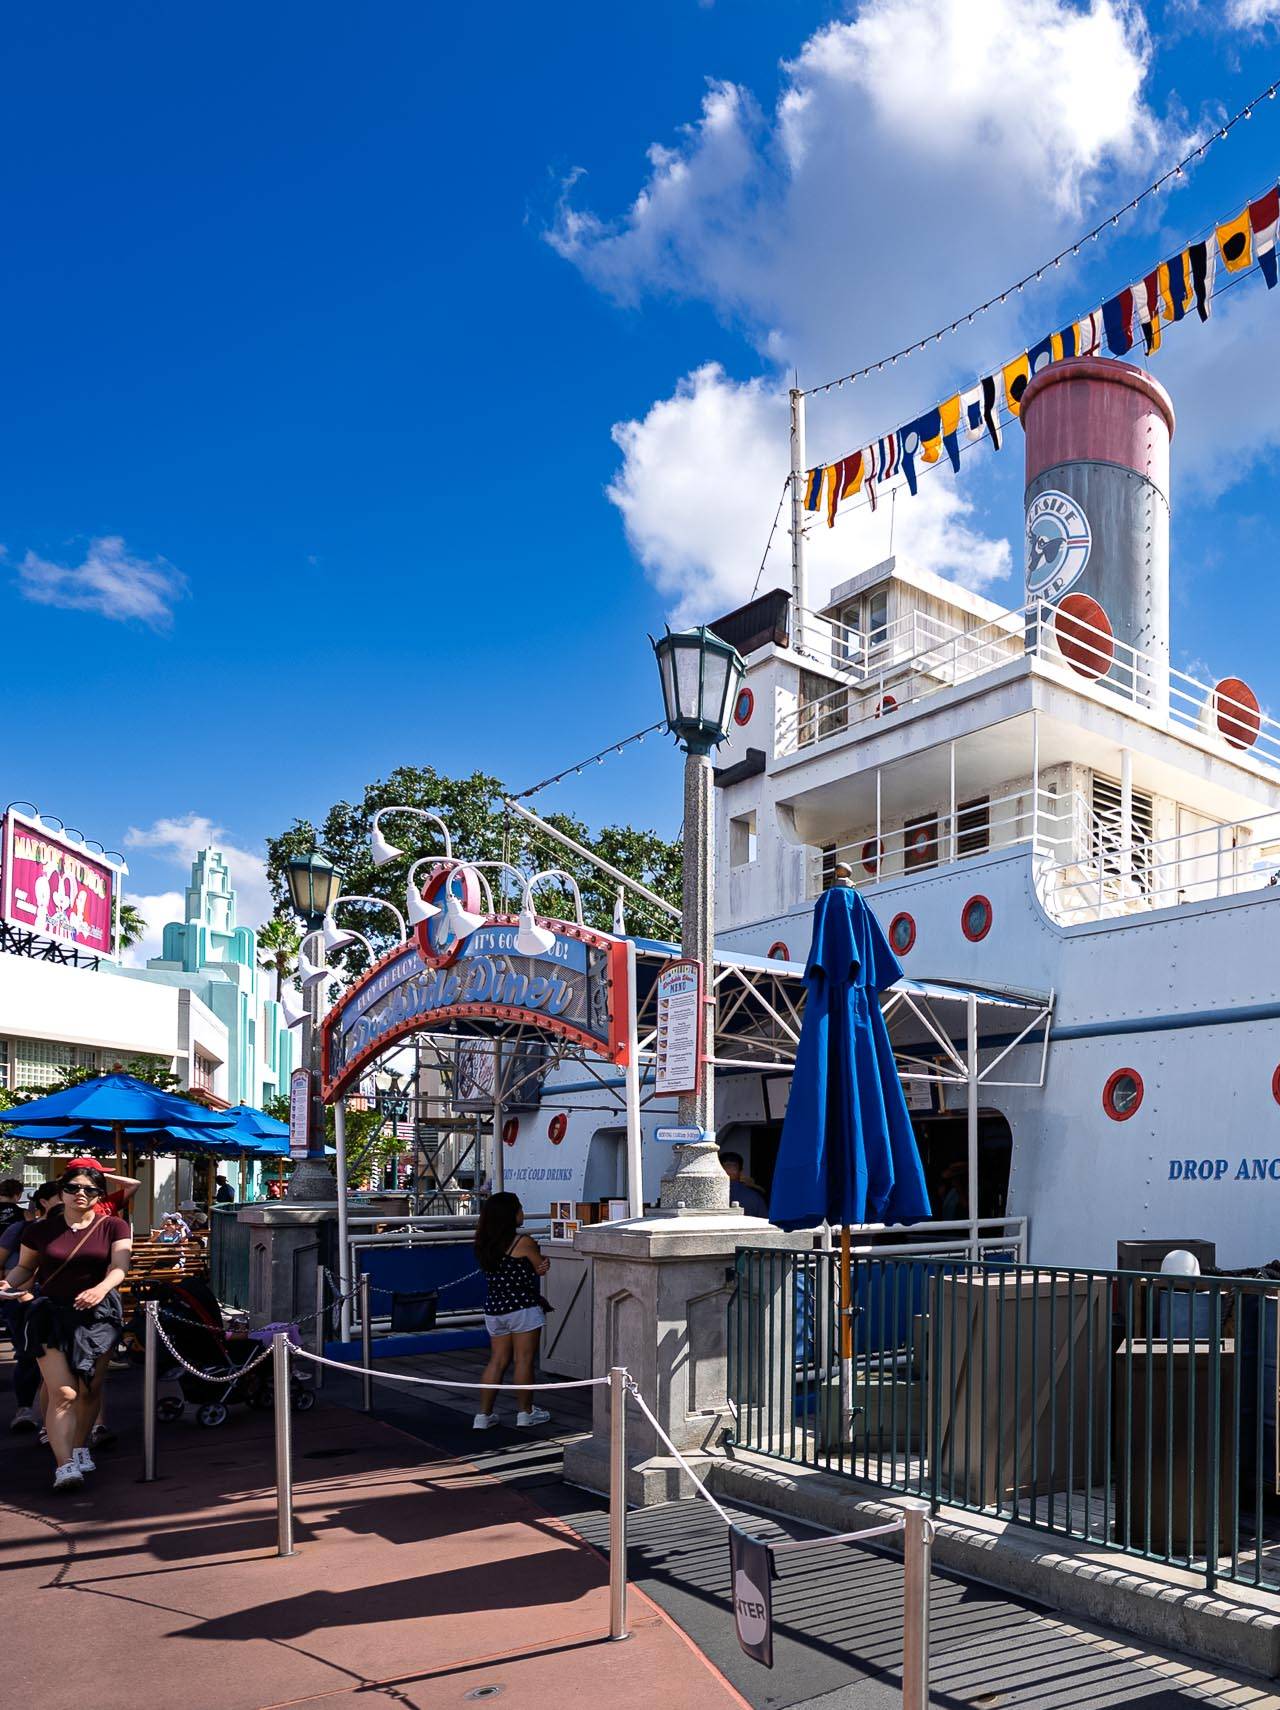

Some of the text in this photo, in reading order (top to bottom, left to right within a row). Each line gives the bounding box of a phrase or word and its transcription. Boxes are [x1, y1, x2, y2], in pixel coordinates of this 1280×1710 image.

[475, 933, 496, 950] IT'S
[462, 955, 574, 1015] Diner
[516, 1168, 528, 1180] ICE
[528, 1168, 546, 1180] COLD
[546, 1168, 573, 1181] DRINKS
[1167, 1159, 1228, 1181] DROP
